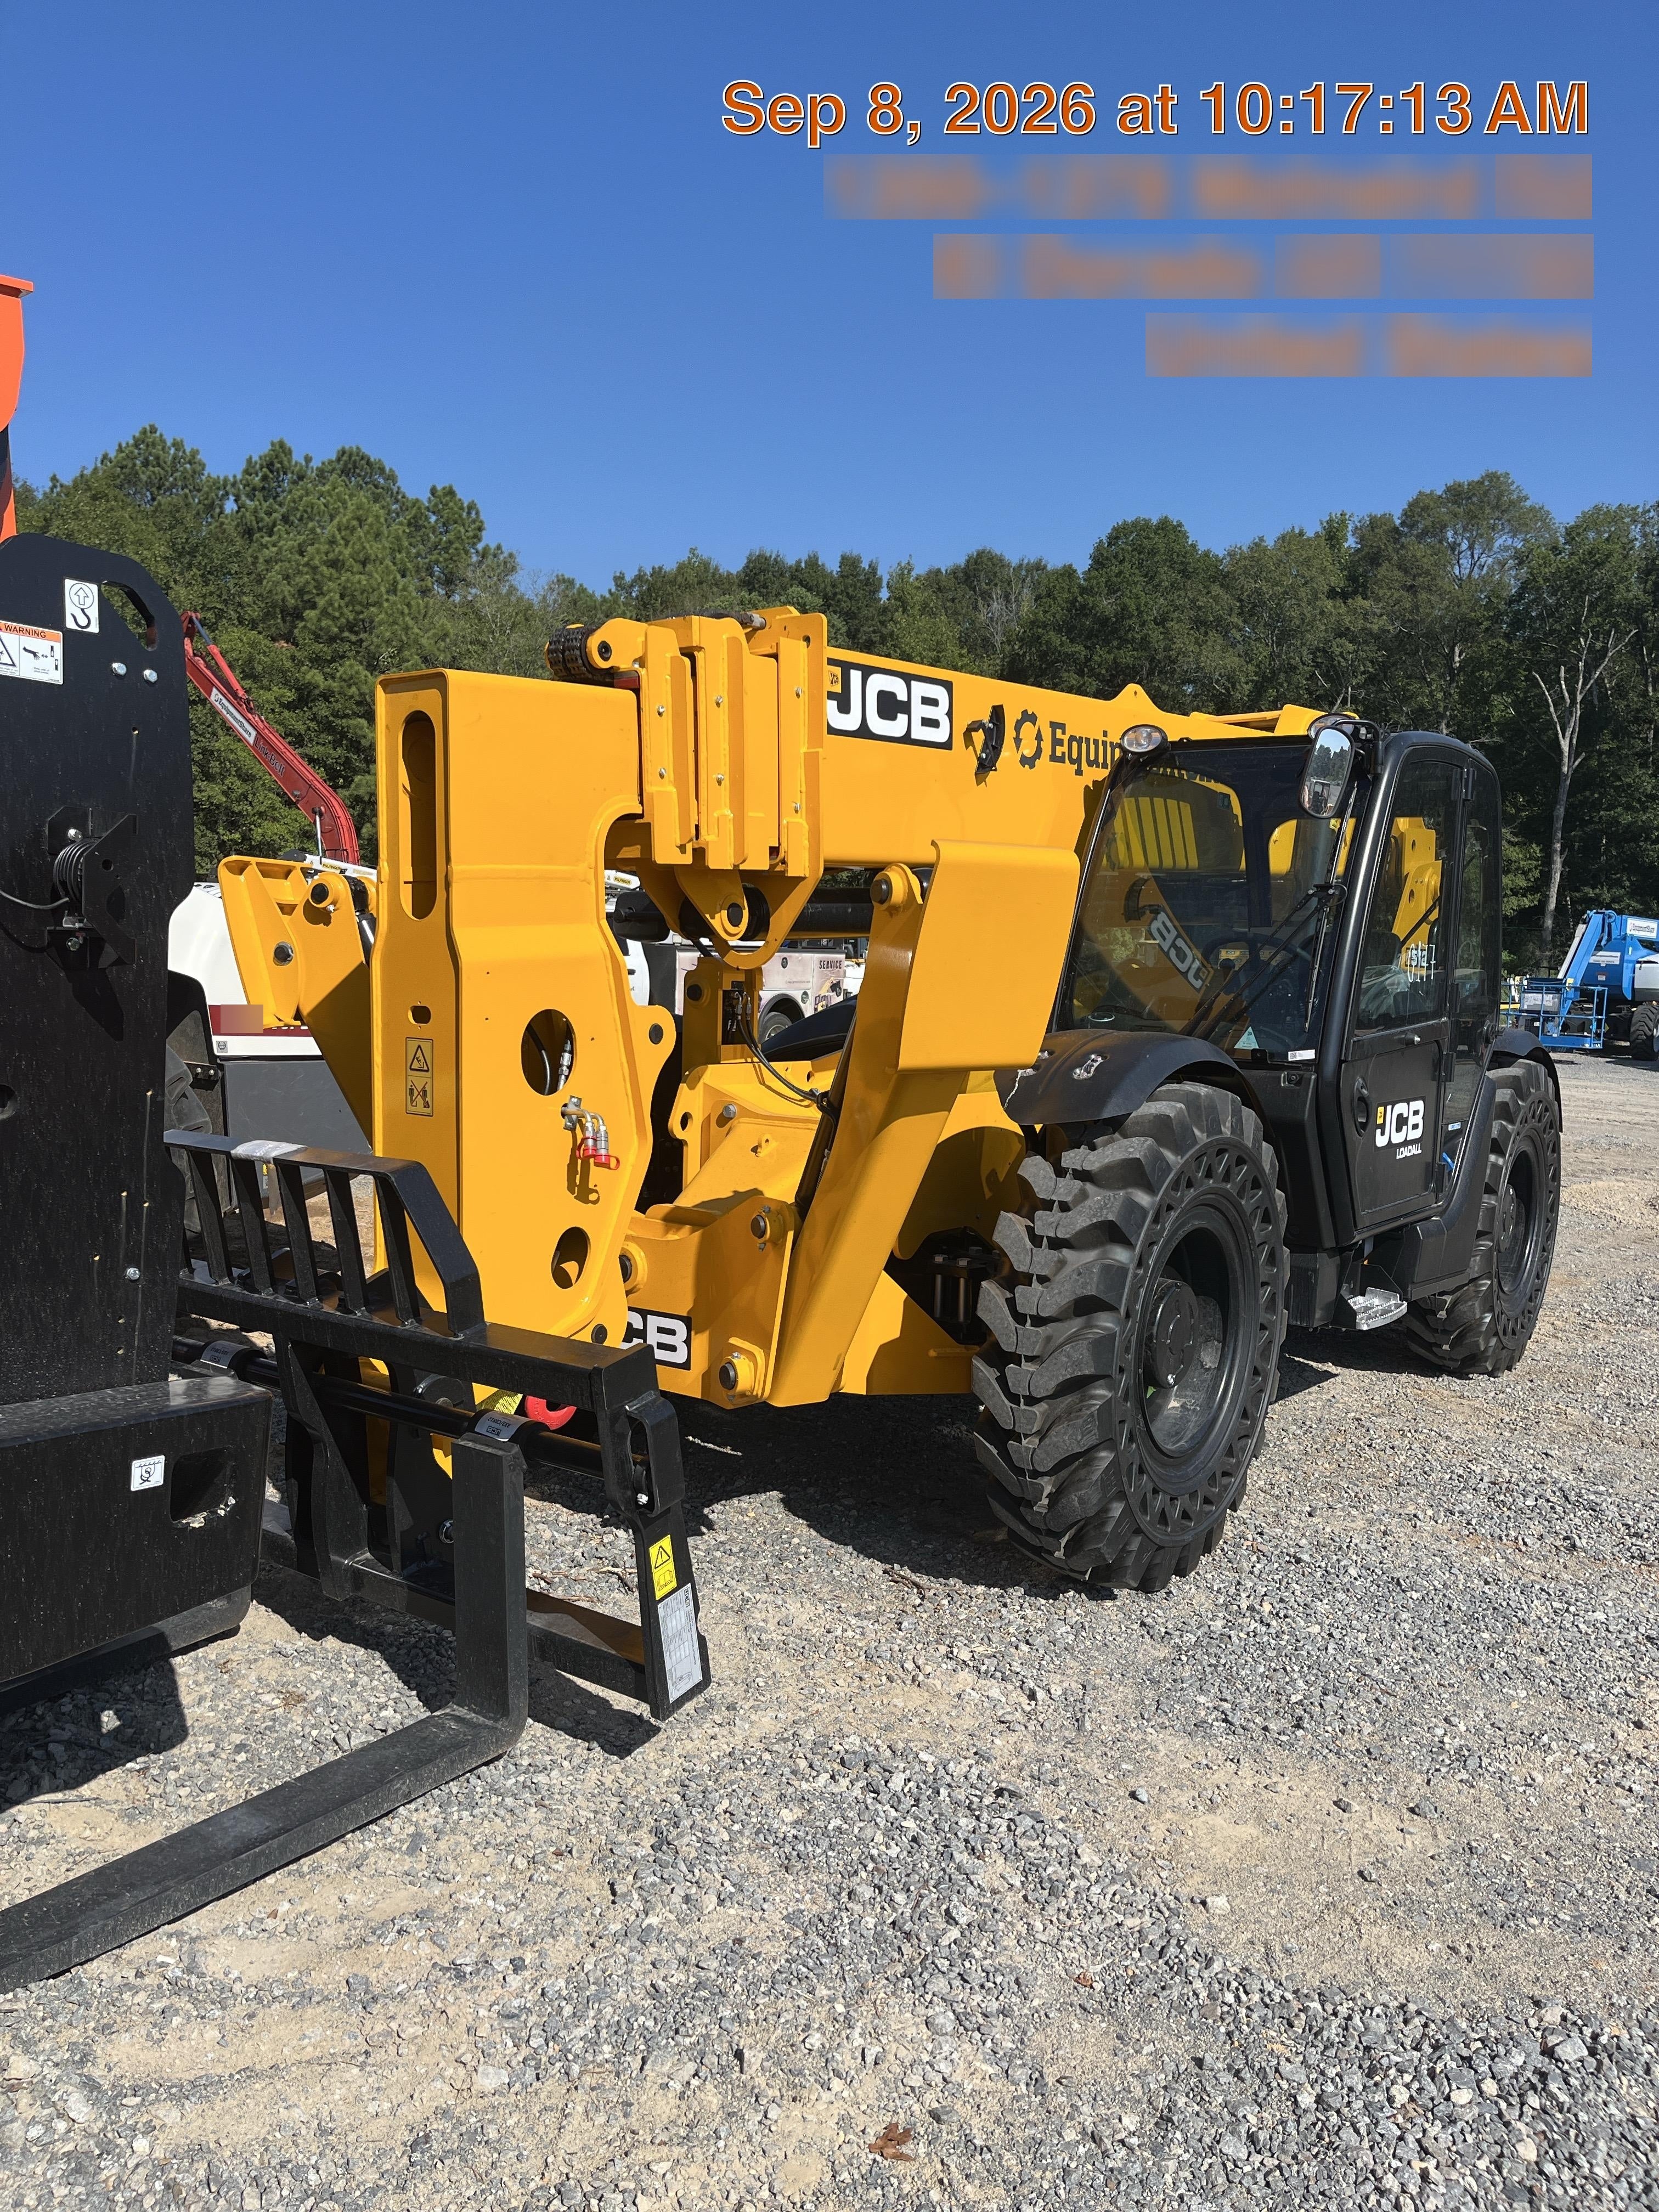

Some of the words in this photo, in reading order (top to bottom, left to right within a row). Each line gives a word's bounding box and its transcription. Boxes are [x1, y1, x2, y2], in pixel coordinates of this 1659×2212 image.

[4, 623, 46, 638] WARNING
[827, 669, 950, 743] JCB
[819, 960, 842, 969] SERVICE
[1375, 1100, 1425, 1147] JCB
[1396, 1143, 1422, 1159] LOADALL
